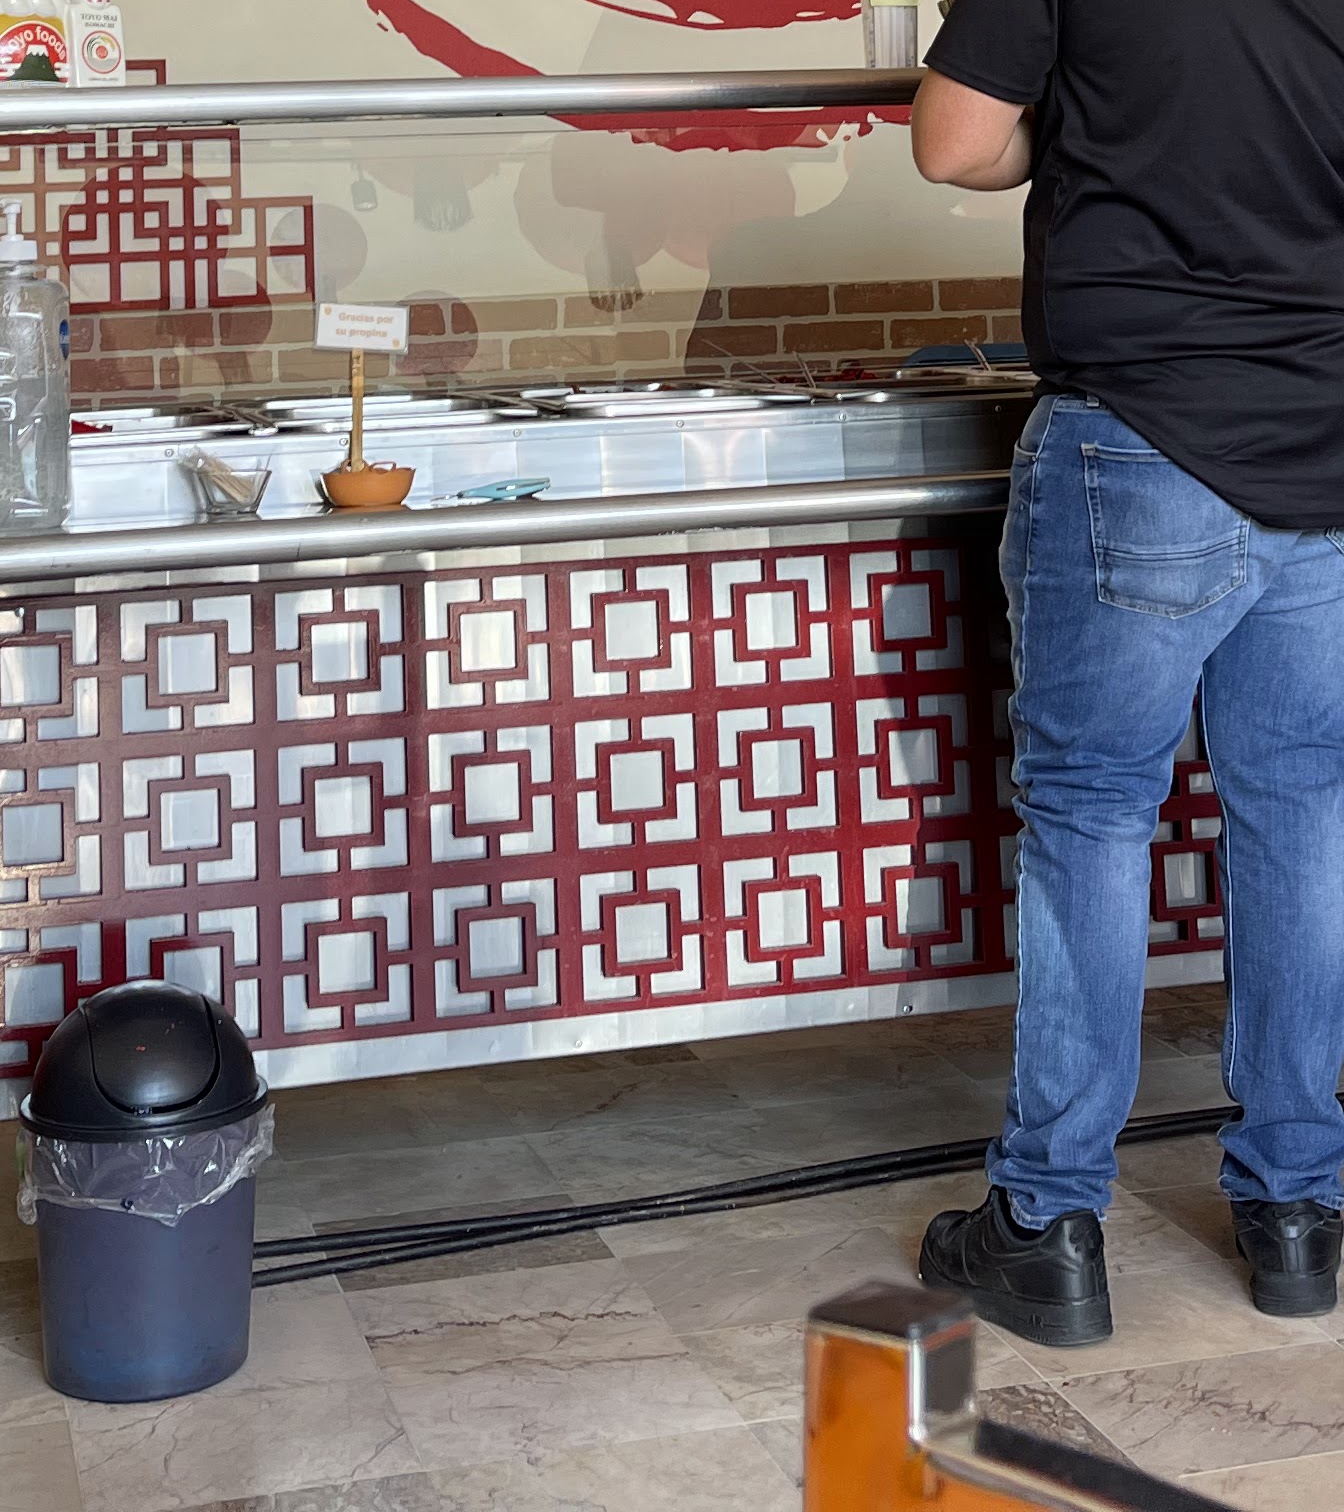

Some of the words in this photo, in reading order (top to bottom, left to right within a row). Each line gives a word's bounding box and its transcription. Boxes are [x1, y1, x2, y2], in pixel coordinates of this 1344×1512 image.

[36, 25, 67, 61] foods
[338, 312, 375, 323] Gracias
[376, 315, 394, 325] por
[336, 328, 347, 336] su
[349, 327, 388, 338] propina
